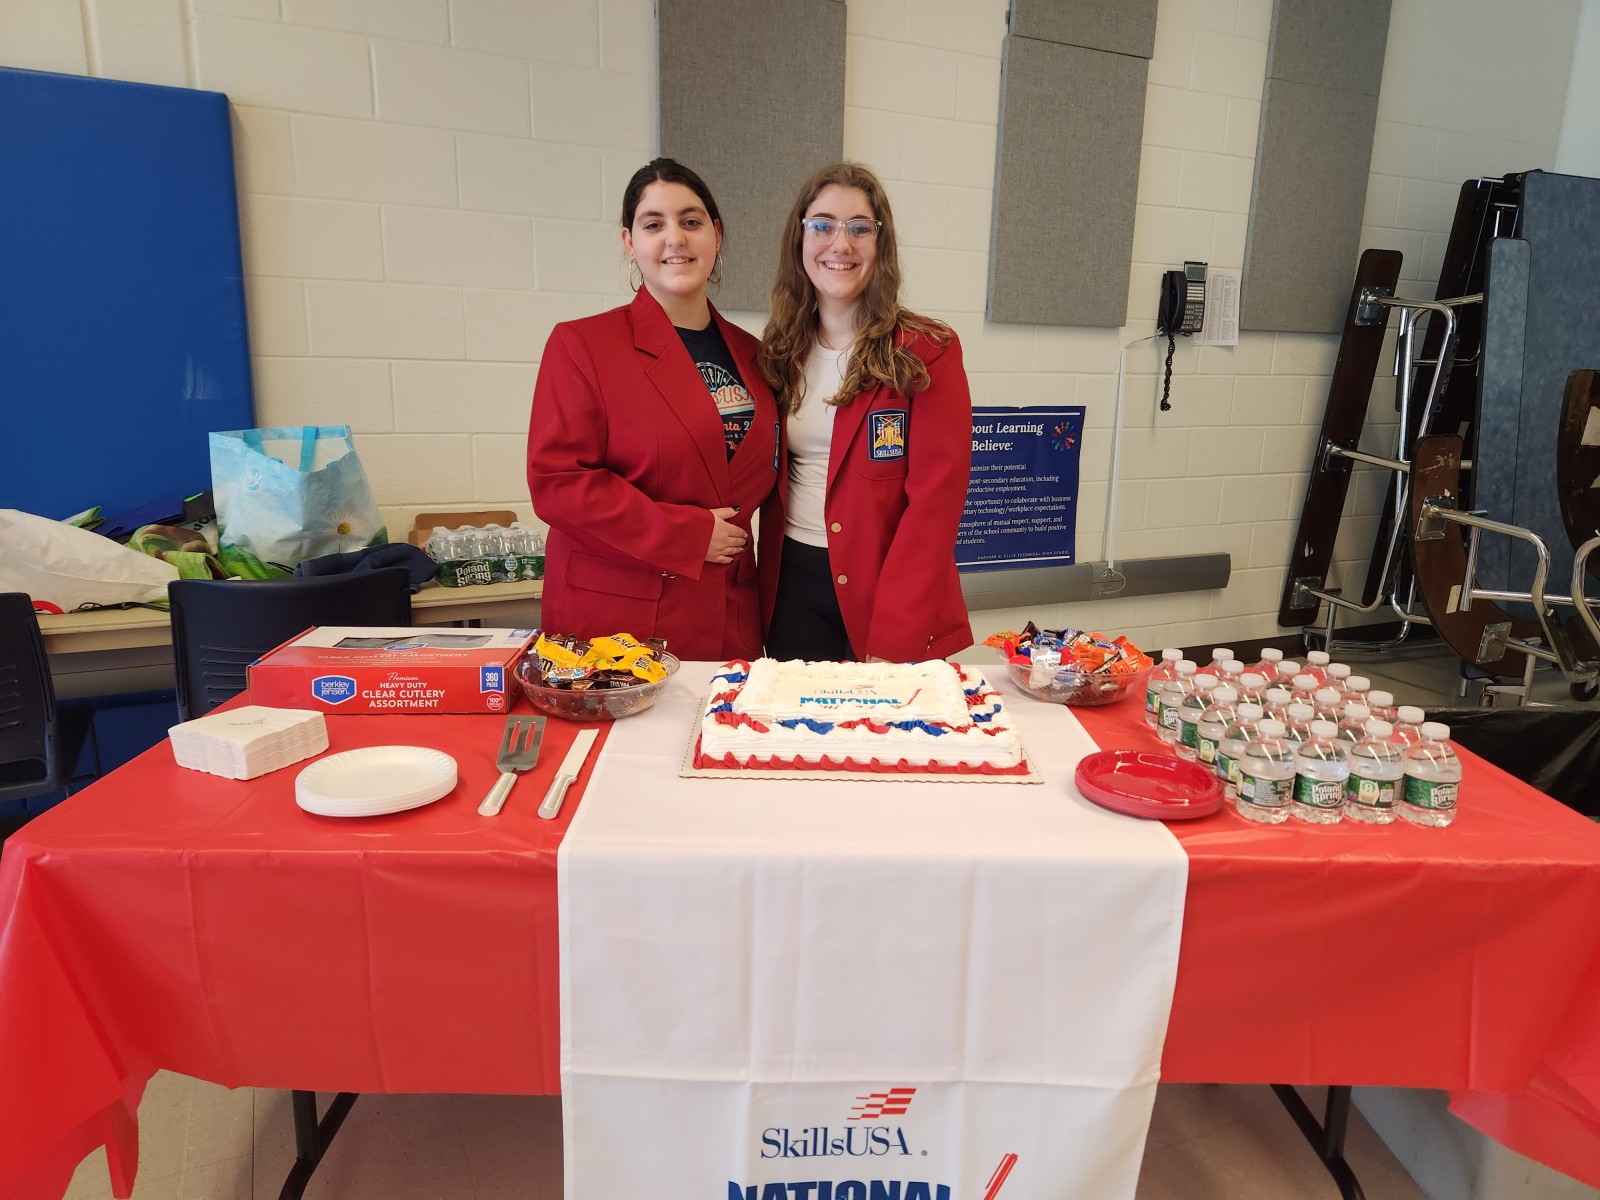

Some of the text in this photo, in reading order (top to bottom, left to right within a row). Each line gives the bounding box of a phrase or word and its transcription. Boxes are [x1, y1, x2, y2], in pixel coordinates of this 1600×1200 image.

[724, 420, 753, 431] nta 2
[996, 421, 1045, 436] Learning
[972, 439, 1014, 452] Believe:
[970, 464, 990, 472] aximize
[991, 463, 1003, 471] their
[1009, 475, 1035, 483] education,
[1036, 475, 1059, 483] including
[967, 486, 994, 494] productive
[974, 498, 1003, 507] opportunity
[960, 520, 986, 528] tmosphere
[983, 527, 1000, 535] school
[1000, 525, 1028, 534] community
[1048, 524, 1067, 532] positive
[455, 561, 490, 578] Poland
[457, 571, 491, 587] Spring
[387, 671, 419, 681] Premium
[485, 672, 499, 682] 360
[321, 680, 350, 688] berkley
[362, 689, 446, 699] CLEAR CUTLERY
[368, 699, 439, 708] ASSORTMENT
[761, 1125, 913, 1158] SkillsUSA
